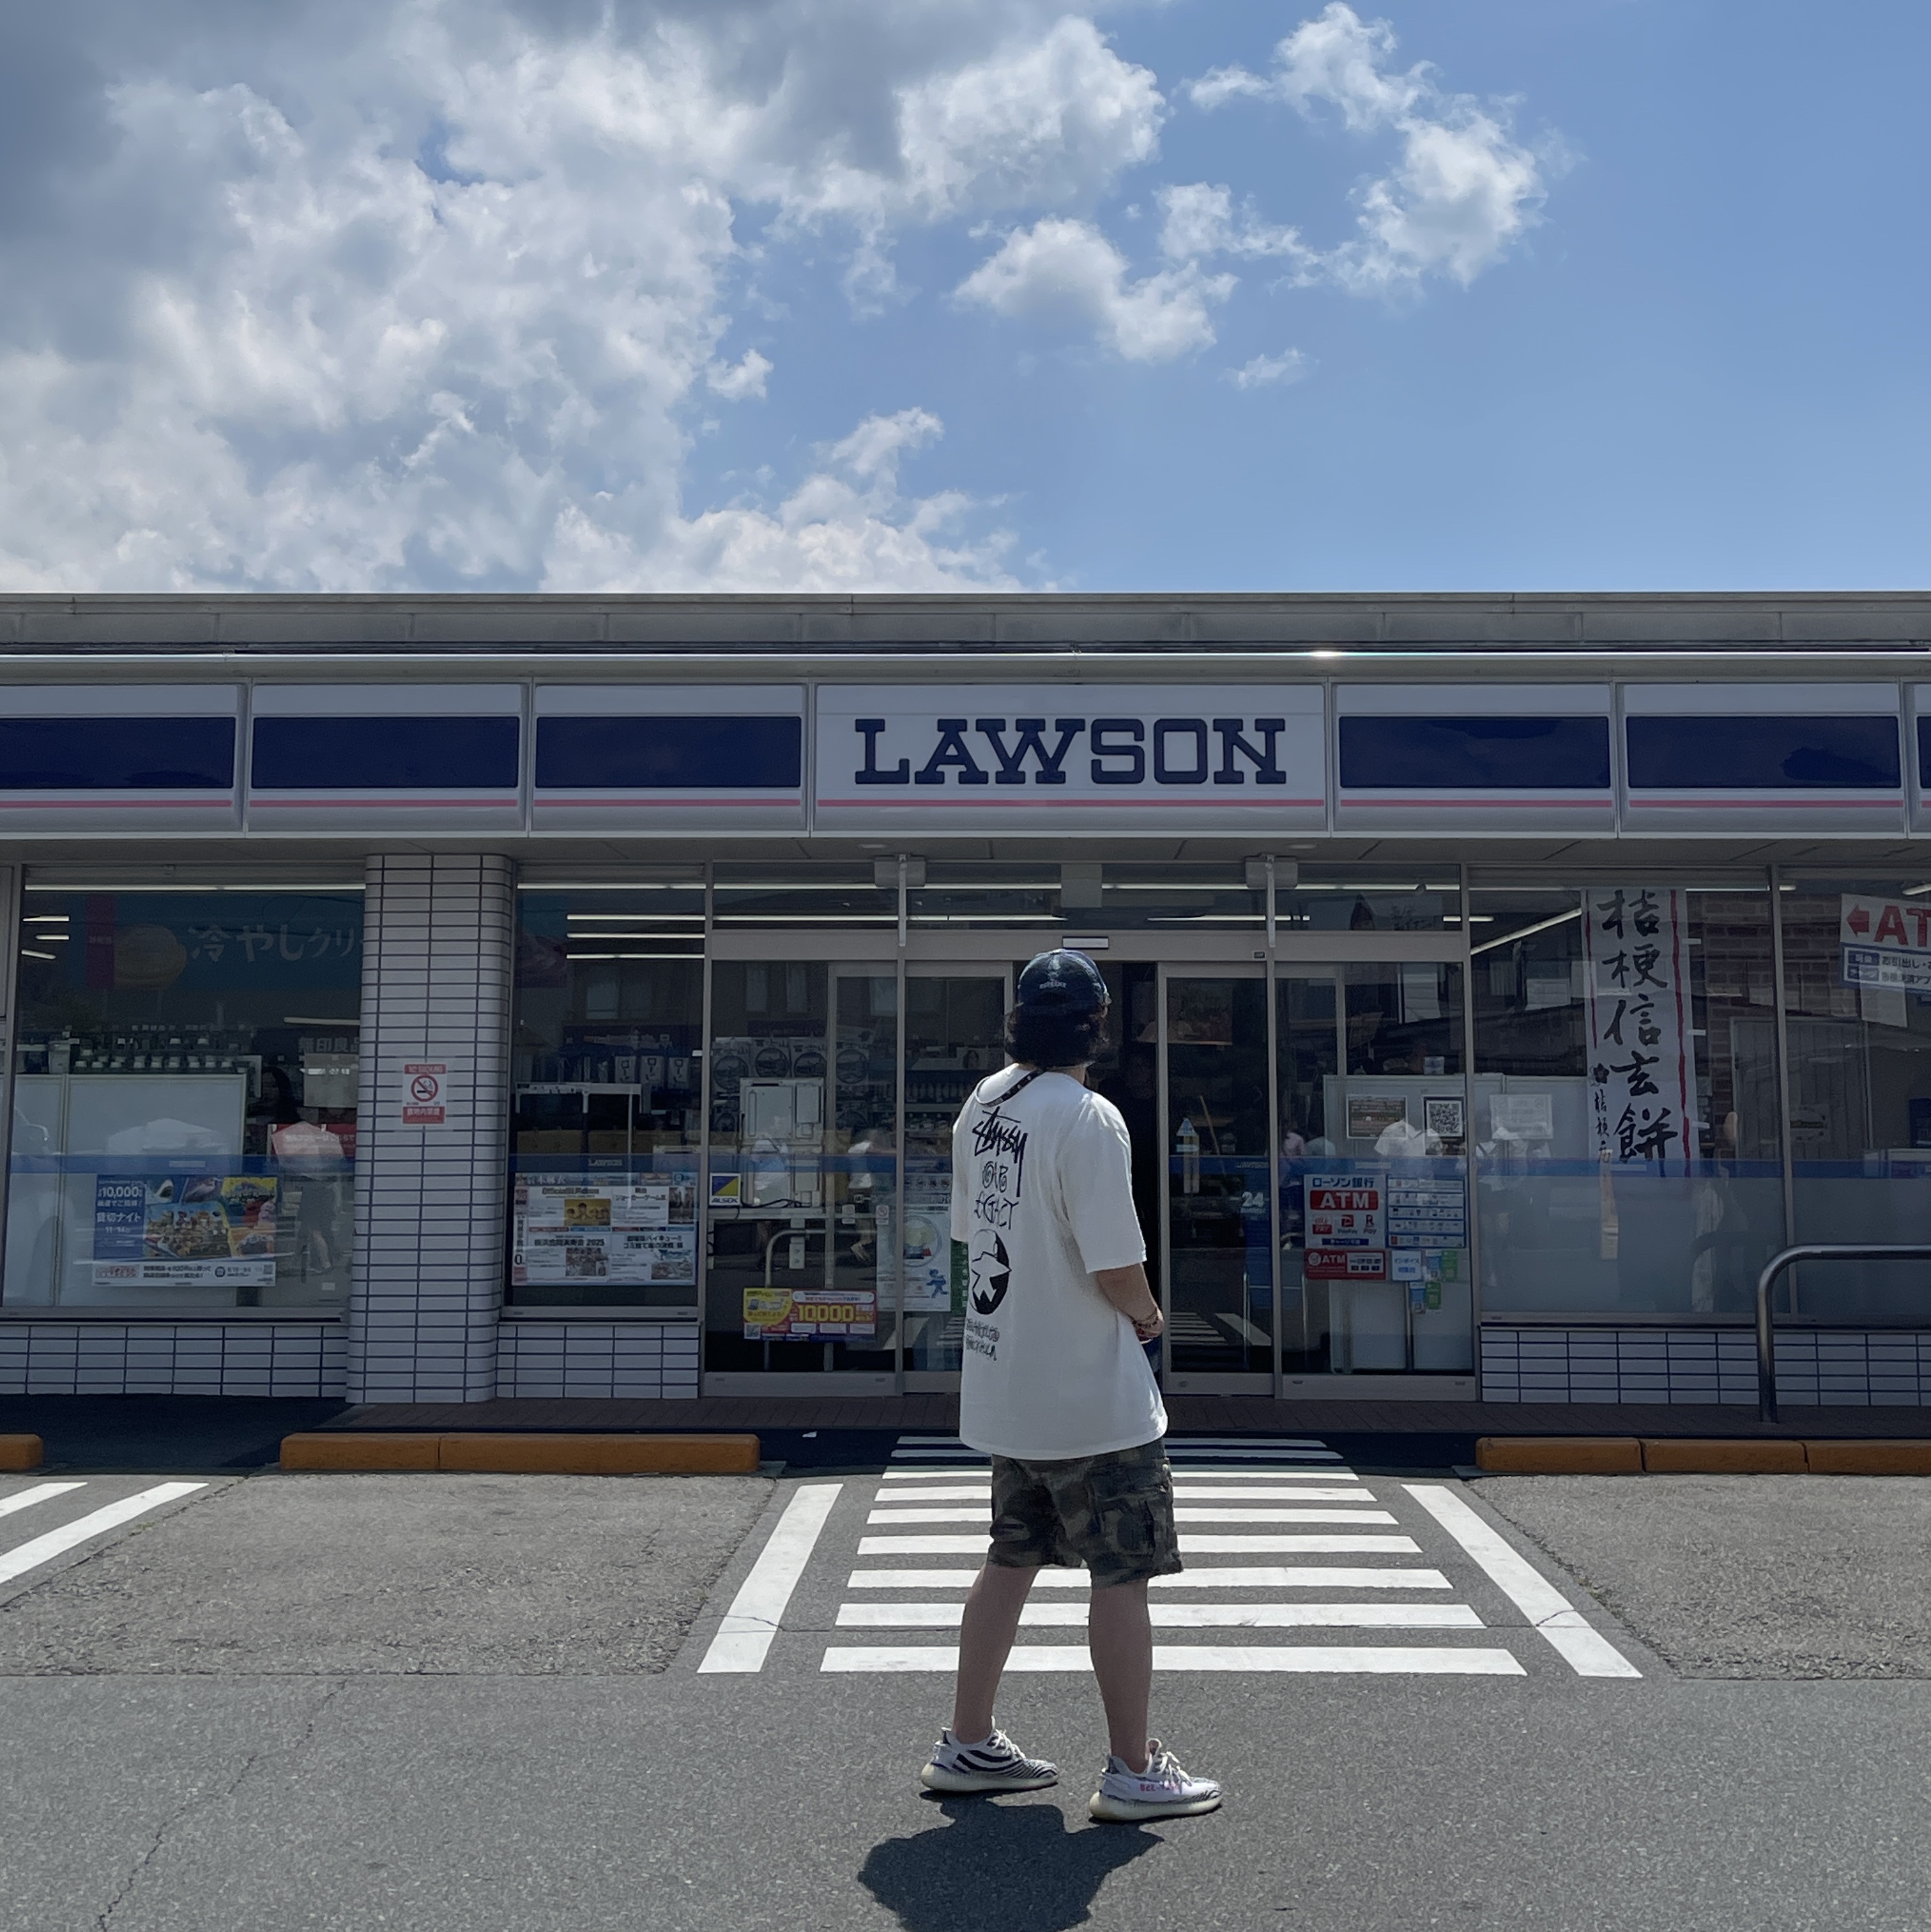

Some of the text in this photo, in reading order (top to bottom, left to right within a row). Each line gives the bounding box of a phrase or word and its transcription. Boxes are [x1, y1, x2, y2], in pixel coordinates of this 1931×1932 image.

[855, 719, 1286, 784] LAWSON
[187, 924, 358, 962] 冷やしクリ
[1596, 889, 1677, 1177] 桔梗信玄餅
[1313, 1177, 1375, 1188] ローソン銀行
[102, 1186, 139, 1199] 10,000
[1242, 1192, 1264, 1208] 24
[1320, 1192, 1370, 1209] ATM
[1322, 1255, 1346, 1264] ATM
